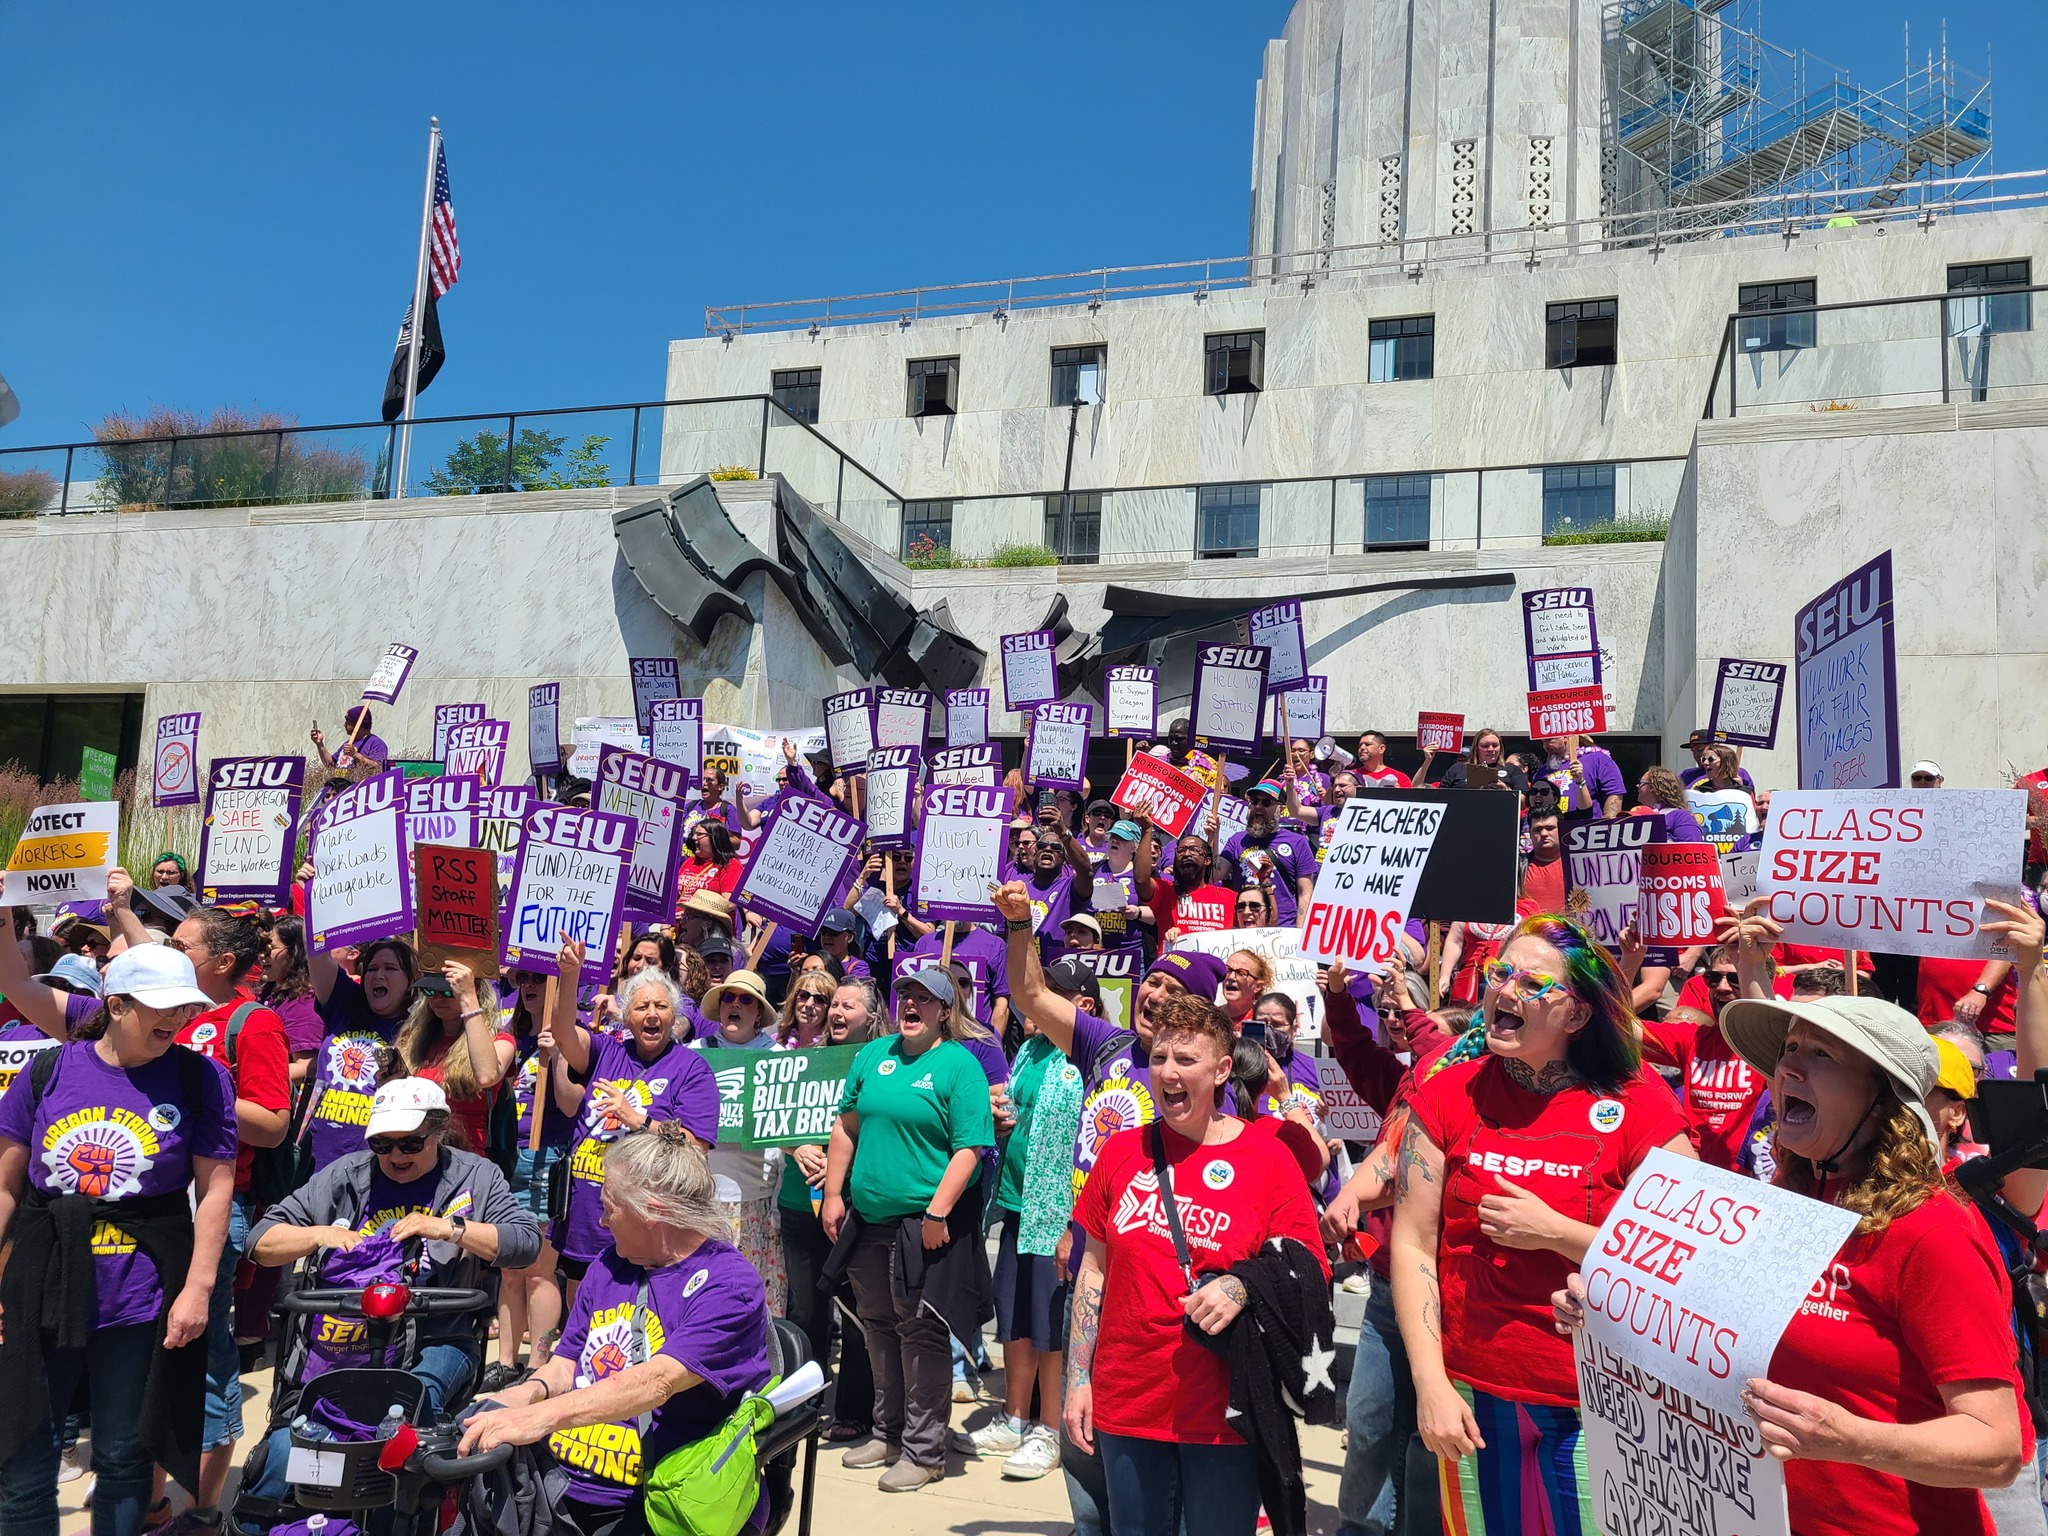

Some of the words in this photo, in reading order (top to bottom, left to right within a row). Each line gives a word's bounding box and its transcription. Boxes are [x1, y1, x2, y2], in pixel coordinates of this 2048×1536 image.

[1530, 591, 1586, 611] SEIU
[1251, 603, 1296, 630] SEIU
[1537, 613, 1551, 622] We
[1554, 610, 1573, 620] need
[1577, 610, 1584, 618] to
[1799, 567, 1880, 662] SEIU
[1004, 634, 1049, 653] SEIU
[634, 661, 674, 677] SEIU
[1008, 655, 1014, 666] 2
[1017, 655, 1048, 667] Steps
[1203, 647, 1263, 668] SEIU
[1537, 661, 1562, 673] Public
[1110, 668, 1153, 681] SEIU
[1541, 671, 1556, 682] NOT
[1725, 662, 1781, 681] SEIU
[1804, 668, 1825, 707] I'LL
[1827, 641, 1868, 692] WORK
[1026, 680, 1043, 688] for
[1112, 685, 1124, 695] We
[1127, 686, 1149, 697] Support
[530, 686, 556, 708] SEIU
[827, 691, 866, 715] SEIU
[880, 689, 927, 706] SEIU
[948, 689, 985, 706] SEIU
[1119, 697, 1144, 708] Oregon
[1211, 693, 1255, 715] Status
[1530, 695, 1543, 703] NO
[1544, 690, 1594, 701] RESOURCES
[1530, 701, 1591, 714] CLASSROOMS
[438, 707, 480, 724] SEIU
[653, 702, 698, 720] SEIU
[831, 715, 851, 735] NO
[853, 711, 869, 731] AI
[880, 711, 917, 727] Stand
[1037, 704, 1087, 724] SEIU
[1111, 710, 1139, 722] Support
[1539, 709, 1595, 736] CRISIS
[1807, 700, 1827, 747] FOR
[1831, 682, 1870, 721] FAIR
[158, 716, 195, 738] SEIU
[654, 721, 683, 734] Unidos
[1208, 713, 1245, 734] Quo
[1419, 723, 1454, 732] CLASSROOMS
[449, 725, 503, 749] SEIU
[704, 741, 742, 757] TECT
[1421, 730, 1454, 749] CRISIS
[1820, 720, 1873, 762] WAGES
[85, 750, 113, 765] OREGON
[90, 761, 112, 778] WORKS
[448, 748, 499, 776] UNION
[868, 749, 912, 771] SEIU
[933, 746, 993, 770] SEIU
[216, 762, 293, 789] SEIU
[604, 753, 681, 799] SEIU
[868, 772, 898, 789] TWO
[956, 770, 985, 785] Need
[1037, 763, 1076, 779] LABOR!
[1134, 756, 1147, 766] NO
[1147, 761, 1195, 794] RESOURCES
[214, 792, 244, 812] KEEP
[244, 790, 290, 811] OREGON
[404, 781, 471, 814] EIU
[868, 791, 901, 809] MORE
[1127, 768, 1185, 803] CLASSROOMS
[1186, 799, 1196, 810] IN
[320, 775, 395, 830] SEIU
[602, 783, 655, 821] WHEN
[926, 790, 1006, 817] SEIU
[1121, 779, 1181, 825] CRISIS
[220, 810, 261, 828] SAFE
[782, 796, 859, 846] SEIU
[868, 809, 898, 832] STEPS
[1346, 804, 1441, 837] TEACHERS
[1778, 807, 1924, 844] CLASS
[317, 829, 358, 853] Make
[530, 810, 627, 854] SEIU
[776, 821, 826, 855] LIVEABLE
[926, 827, 987, 850] Union
[1569, 820, 1653, 851] SEIU
[13, 843, 87, 865] WORKERS
[213, 835, 271, 856] FUND
[787, 843, 819, 868] WAGE
[1329, 843, 1377, 865] JUST
[1380, 845, 1429, 868] WANT
[210, 858, 238, 876] State
[241, 857, 281, 873] Workers
[432, 856, 478, 885] RSS
[524, 843, 568, 876] FUND
[568, 850, 617, 885] PEOPLE
[761, 853, 820, 888] EQUITABLE
[1571, 850, 1641, 887] UNION
[1642, 852, 1709, 866] SOURCES
[1771, 849, 1883, 886] SIZE
[27, 872, 77, 891] NOW!
[755, 869, 801, 900] WORKLOAD
[801, 891, 825, 910] NOW
[1335, 873, 1354, 890] TO
[1363, 873, 1404, 897] HAVE
[1640, 875, 1706, 890] SROOMS
[1710, 875, 1723, 889] IN
[431, 885, 477, 907] Staff
[526, 884, 555, 901] FOR
[567, 886, 597, 907] THE
[1177, 900, 1224, 921] UNITE!
[1639, 890, 1713, 940] RISIS
[1768, 890, 1974, 937] COUNTS
[326, 928, 342, 938] Service
[341, 921, 361, 935] Employees
[361, 913, 388, 930] International
[388, 910, 403, 921] Union
[427, 910, 492, 937] MATTER
[518, 905, 610, 950] FUTURE!
[1302, 903, 1402, 964] FUNDS
[753, 1056, 809, 1086] STOP
[1690, 1058, 1753, 1091] UNITE
[752, 1078, 846, 1113] BILLIONA
[1698, 1099, 1742, 1111] TOGETHER
[42, 1106, 106, 1151] OREGON
[110, 1106, 161, 1156] STRONG
[753, 1110, 791, 1140] TAX
[794, 1107, 838, 1137] BRE
[1468, 1150, 1582, 1178] RESPECT
[1632, 1172, 1762, 1246] CLASS
[359, 1205, 407, 1239] OREGON
[1602, 1218, 1698, 1287] SIZE
[1585, 1265, 1741, 1380] COUNTS
[1580, 1362, 1645, 1443] NEED
[1659, 1408, 1755, 1521] MORE
[548, 1432, 646, 1487] STRONG
[1615, 1433, 1716, 1536] THAN
